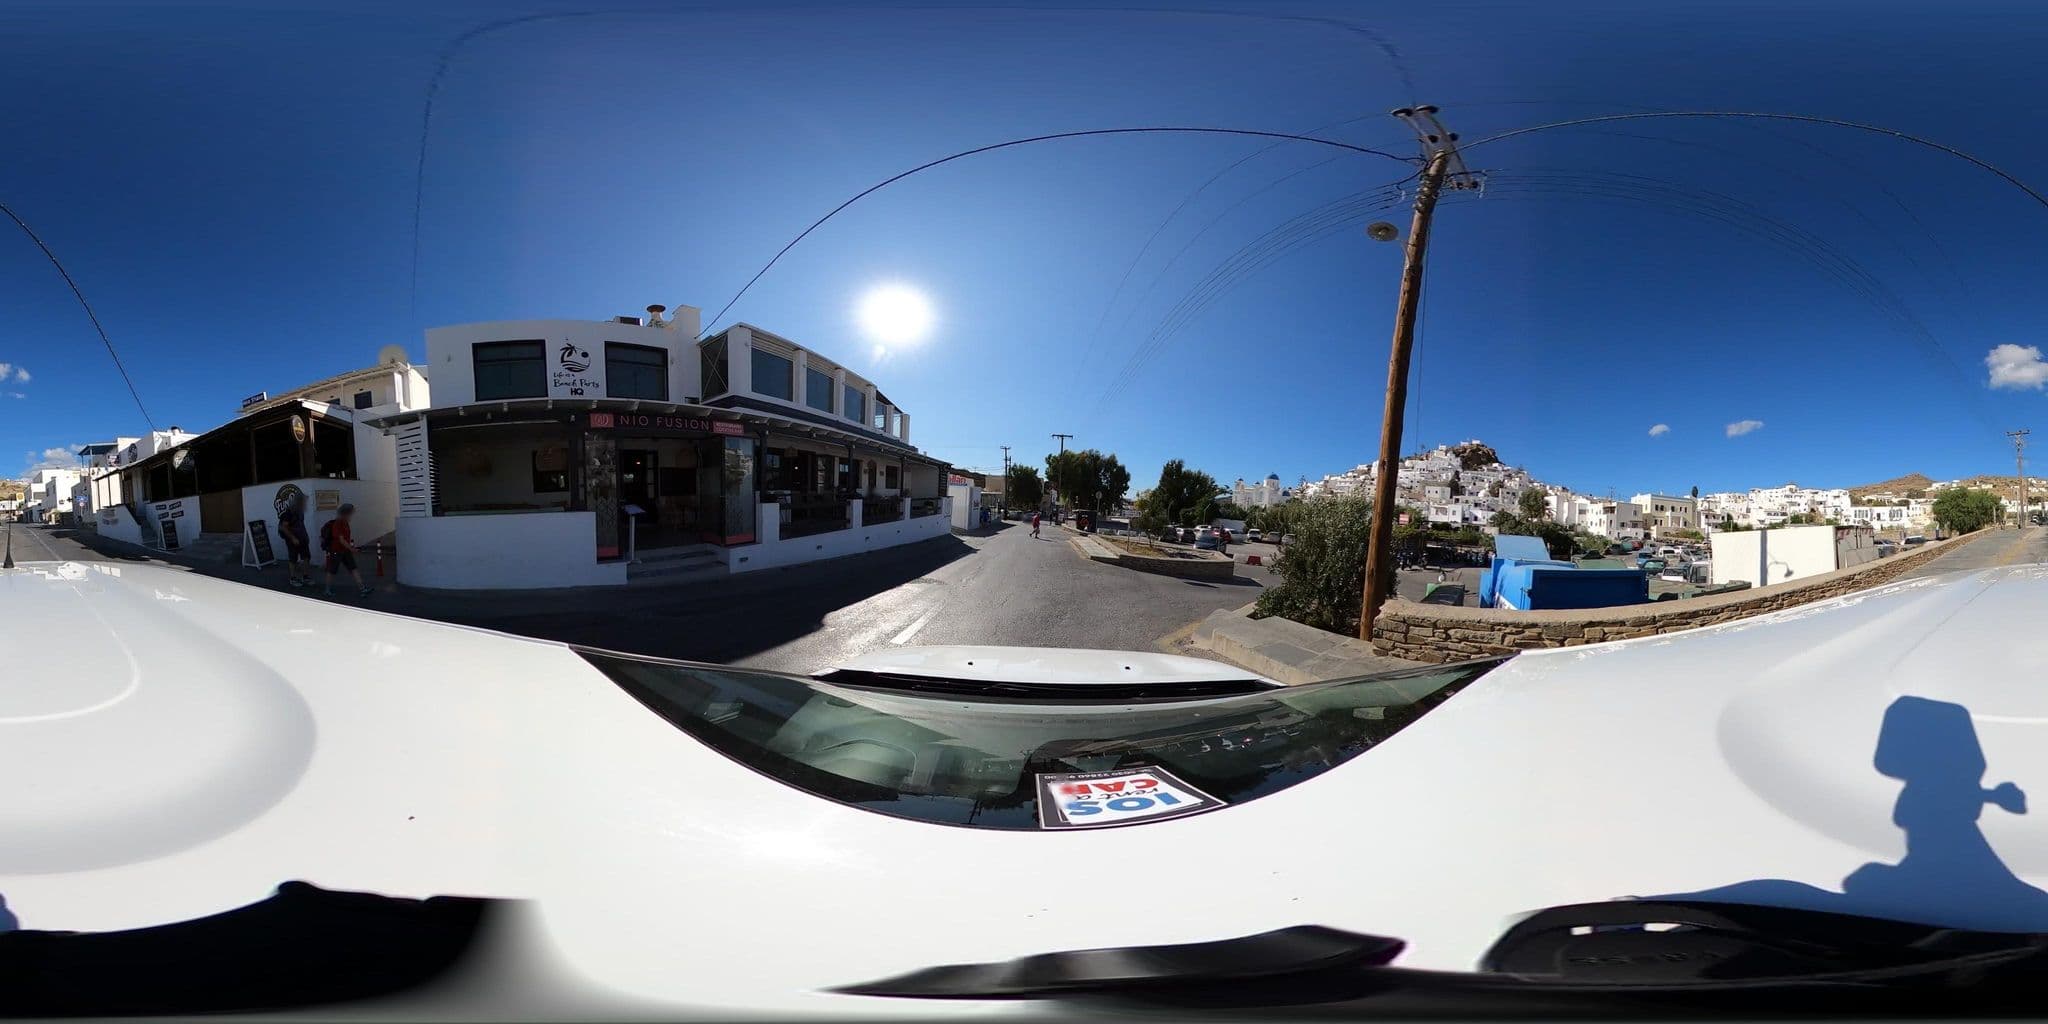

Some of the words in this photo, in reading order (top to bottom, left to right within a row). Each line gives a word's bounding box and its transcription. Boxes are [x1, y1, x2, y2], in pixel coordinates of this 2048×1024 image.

[553, 378, 578, 388] Beach
[570, 387, 585, 396] HQ
[619, 415, 649, 426] NIO
[656, 416, 710, 431] FUSION
[1098, 787, 1159, 800] rent
[1067, 792, 1182, 816] IOS
